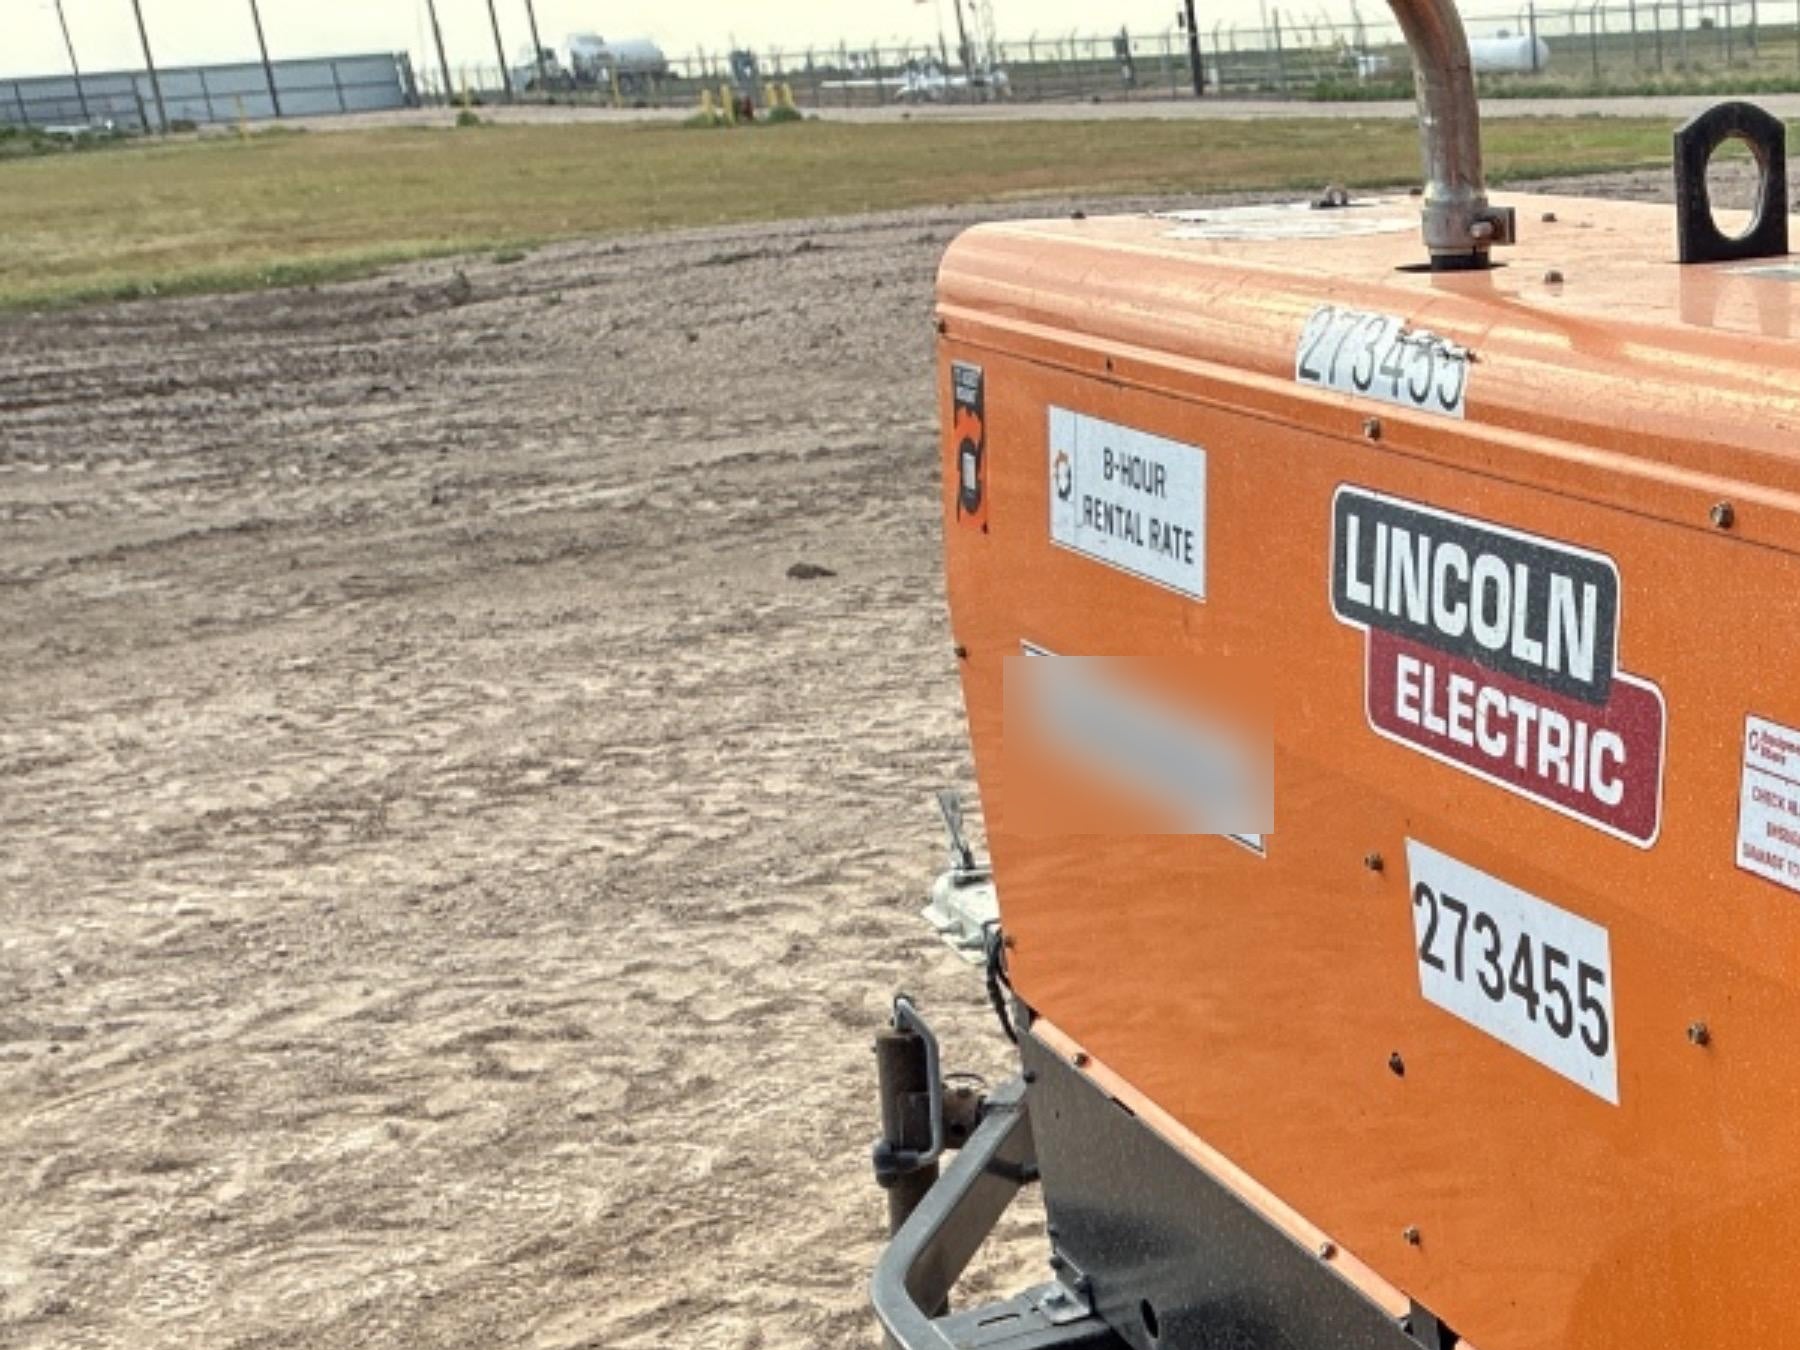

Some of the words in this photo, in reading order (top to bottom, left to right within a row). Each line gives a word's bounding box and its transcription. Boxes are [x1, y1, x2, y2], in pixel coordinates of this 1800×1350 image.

[1083, 495, 1144, 547] RENTAL
[1149, 518, 1194, 565] RATE
[1345, 513, 1597, 682] LINCOLN
[1397, 655, 1625, 806] ELECTRIC
[1751, 785, 1786, 812] CHECK
[1413, 881, 1610, 1058] 273455
